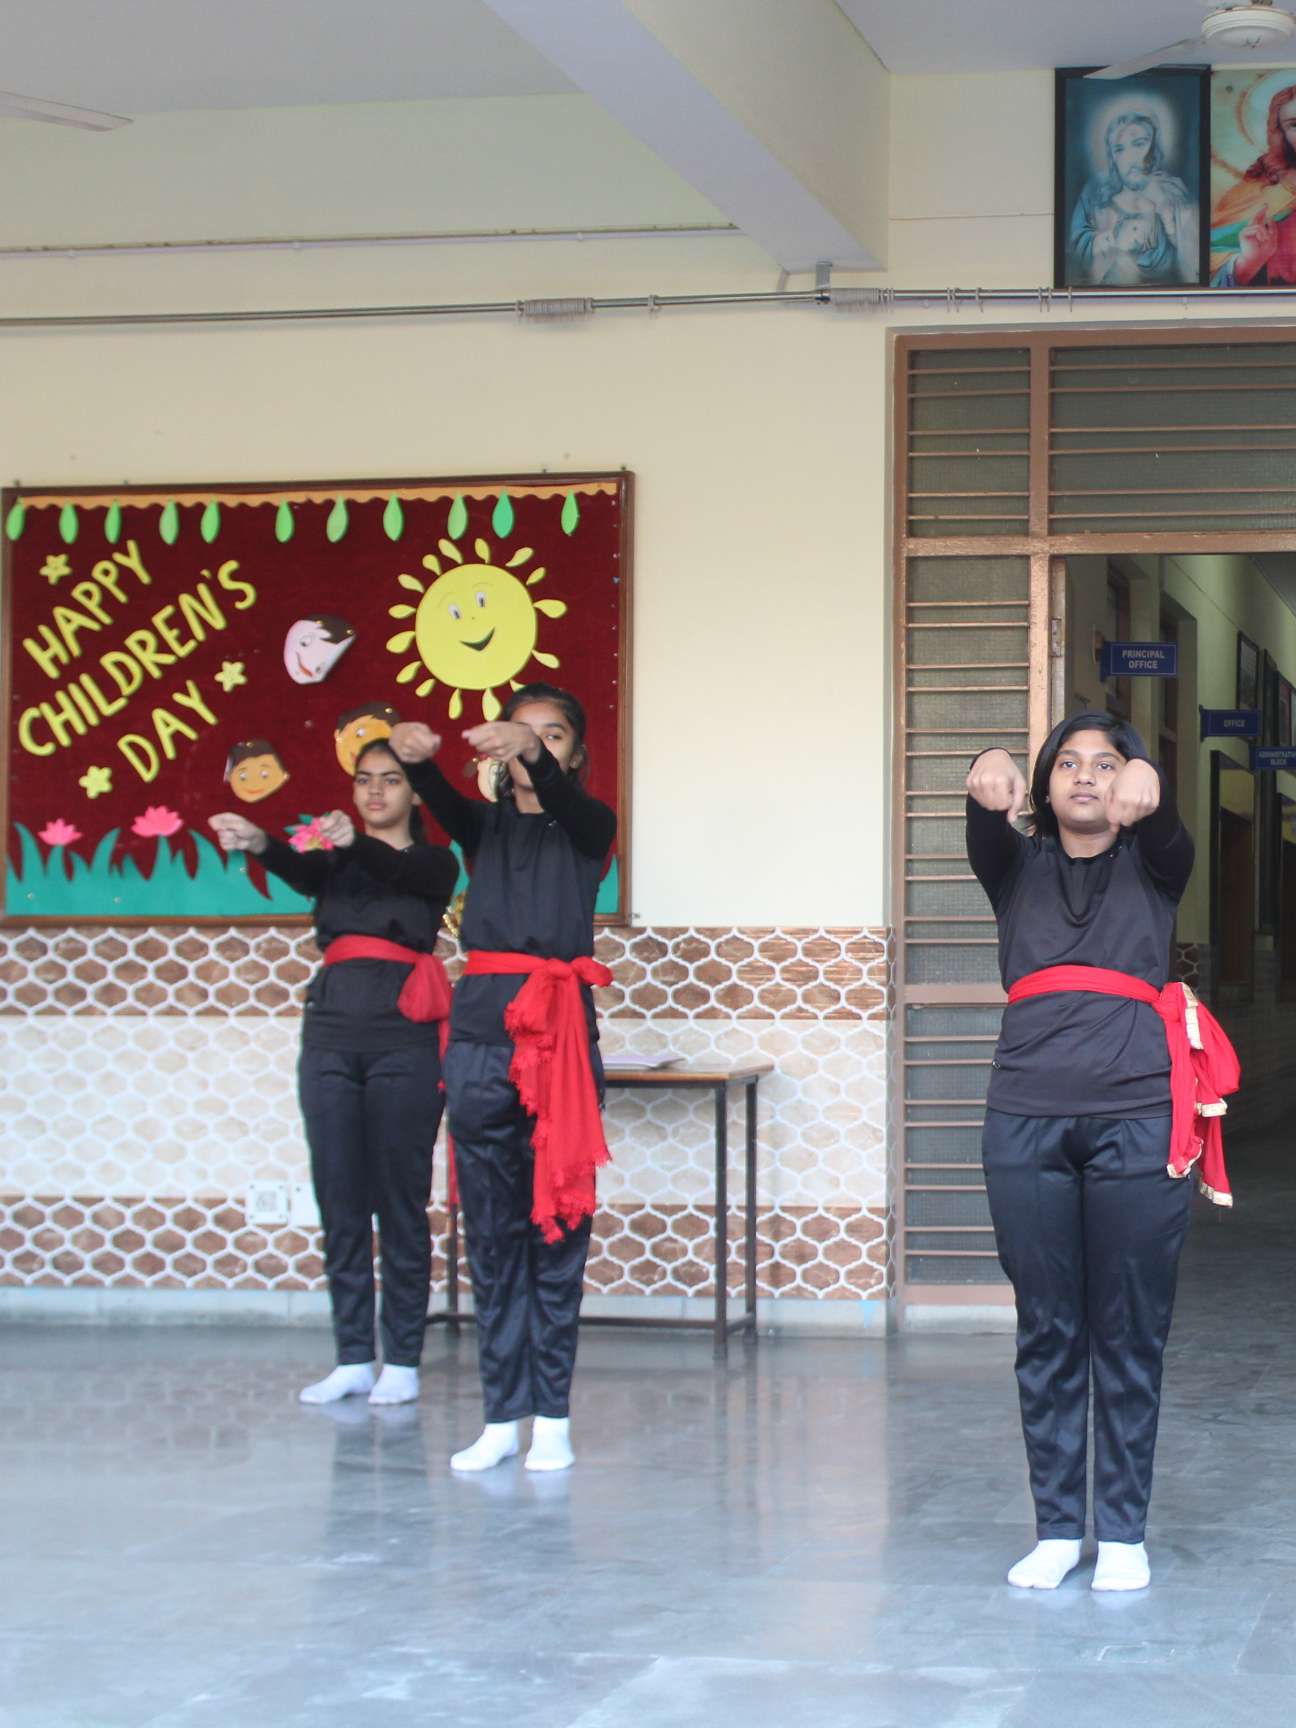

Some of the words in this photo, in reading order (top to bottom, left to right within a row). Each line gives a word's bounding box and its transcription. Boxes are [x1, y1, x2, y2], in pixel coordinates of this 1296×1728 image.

[18, 559, 257, 757] CHILDREN'S
[22, 539, 152, 680] HAPPY
[1121, 649, 1166, 659] PRINCIPAL
[1128, 660, 1159, 669] OFFICE
[116, 679, 219, 783] DAY
